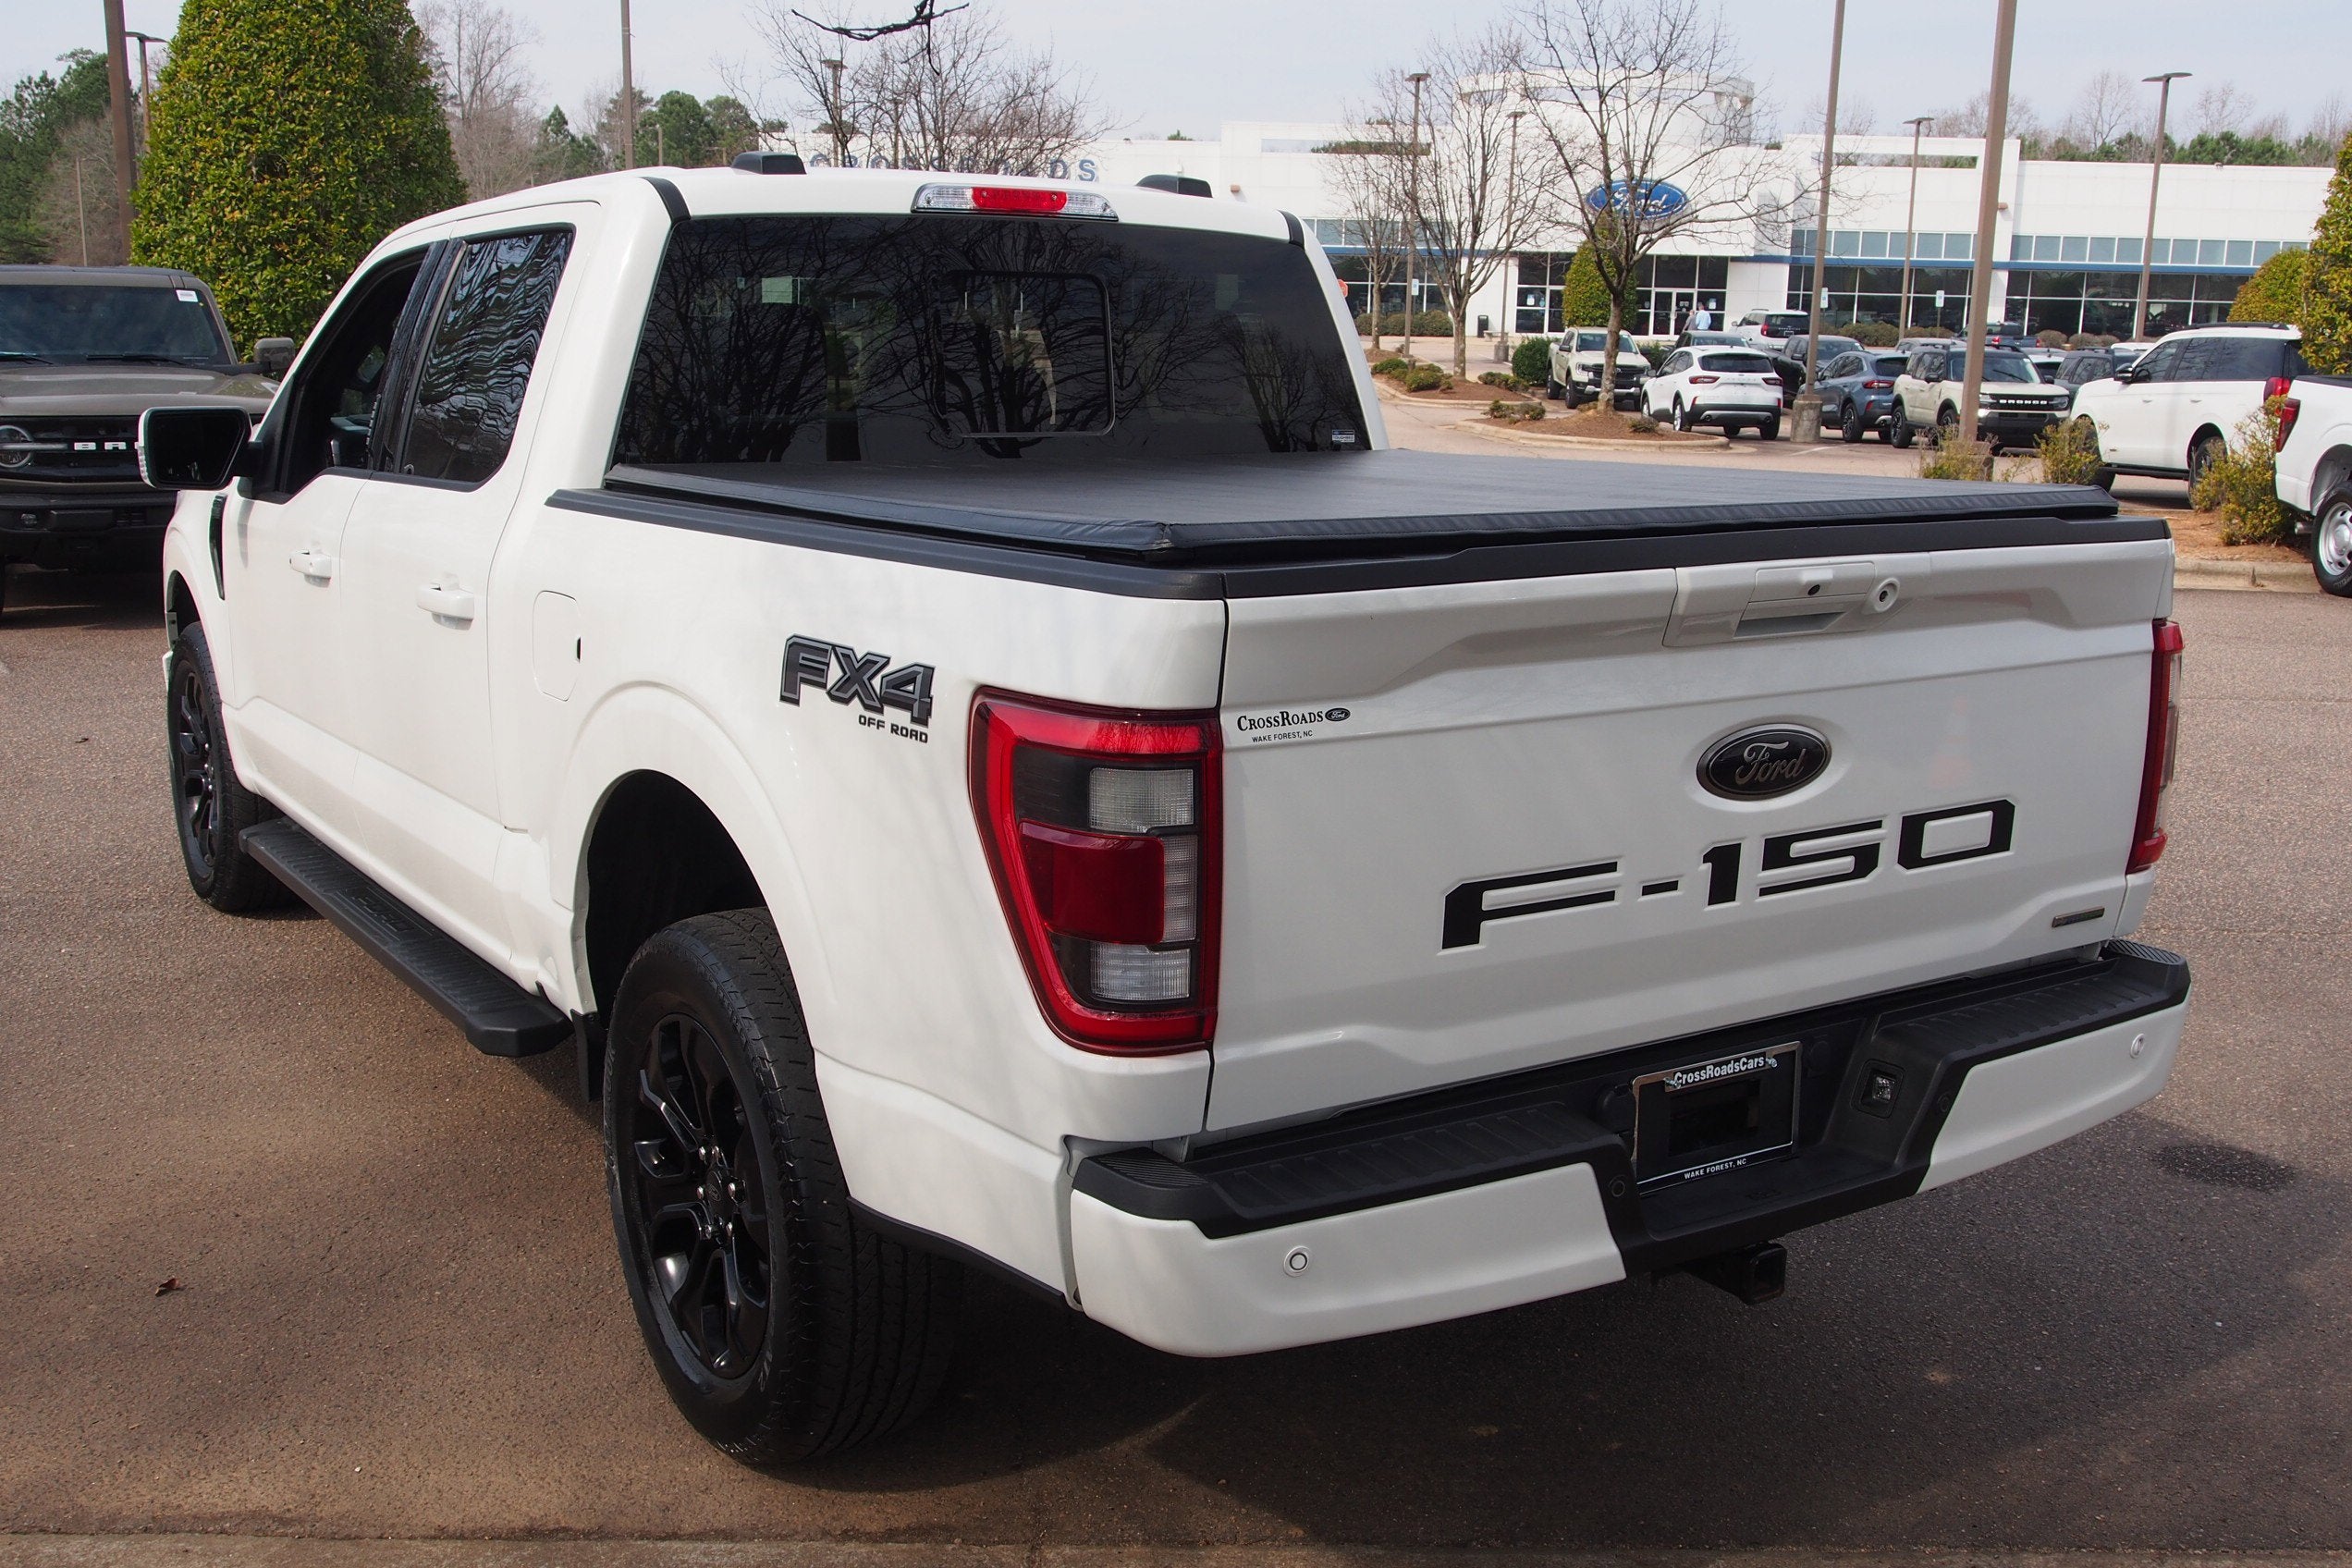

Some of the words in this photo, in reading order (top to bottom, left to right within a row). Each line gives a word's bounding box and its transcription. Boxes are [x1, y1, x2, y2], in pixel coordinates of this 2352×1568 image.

[779, 633, 936, 729] FX4
[858, 714, 886, 730] OFF
[890, 722, 929, 744] ROAD
[1251, 734, 1272, 743] WAKE
[1274, 730, 1303, 741] FOREST,
[1304, 729, 1314, 738] NC
[1734, 741, 1807, 786] Ford
[1441, 798, 2015, 950] F-150
[1673, 1056, 1765, 1084] CrossRoadsCars
[1684, 1168, 1705, 1180] WAKE
[1706, 1161, 1735, 1174] FOREST,
